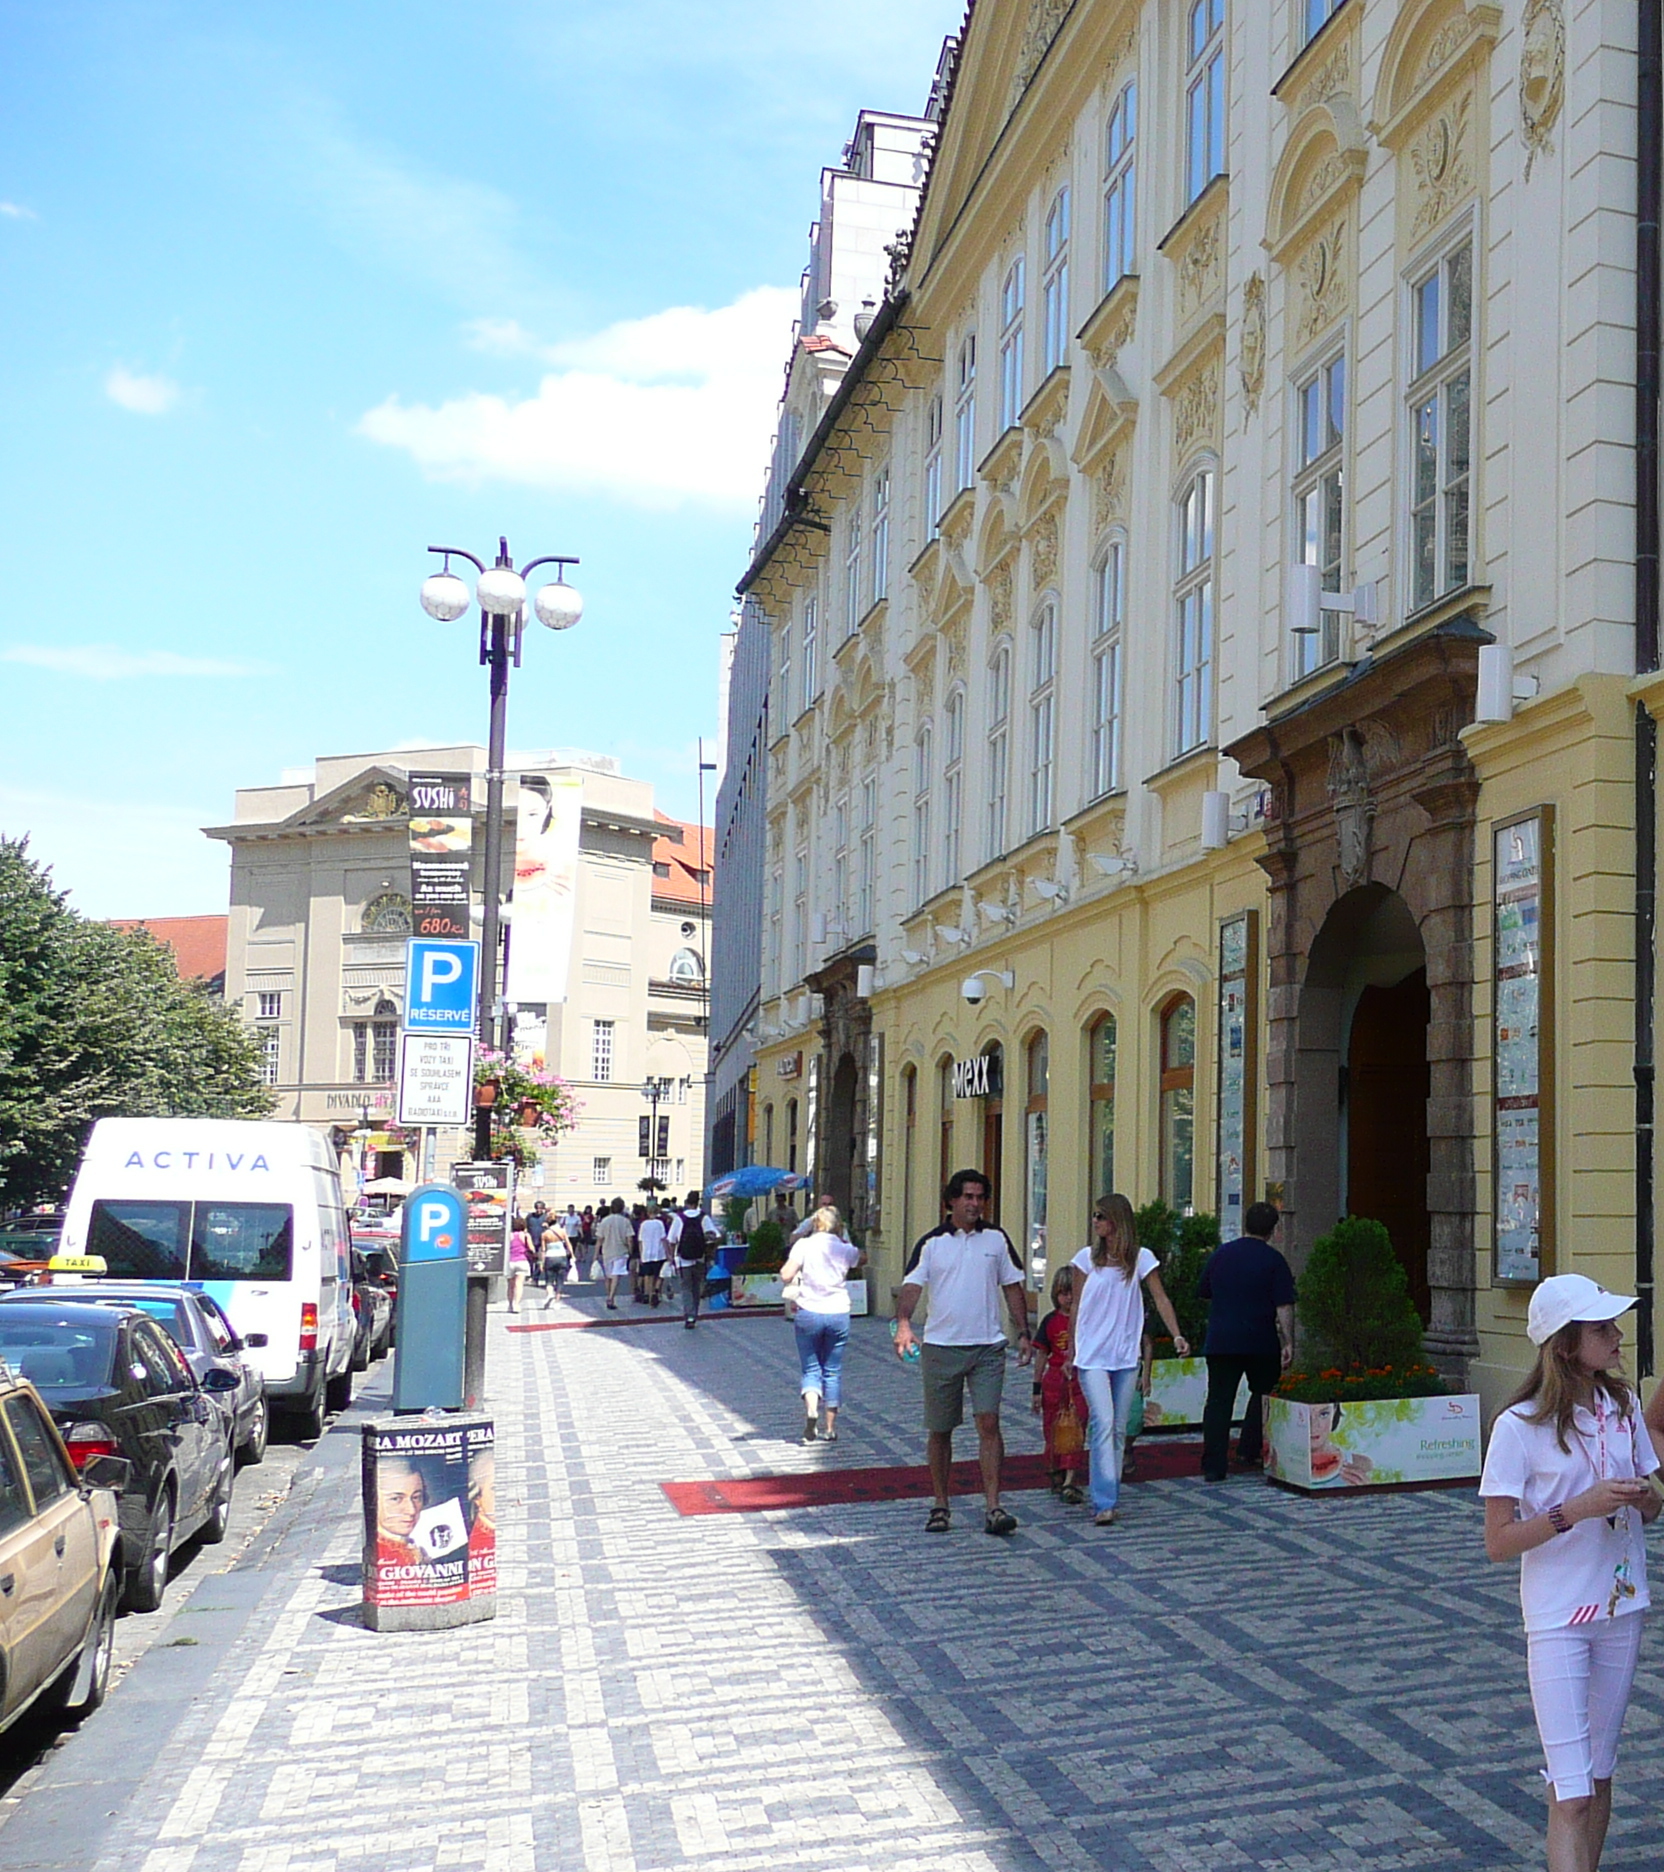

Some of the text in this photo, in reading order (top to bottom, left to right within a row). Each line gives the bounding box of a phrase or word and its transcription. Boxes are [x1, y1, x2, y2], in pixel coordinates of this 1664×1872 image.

[420, 917, 451, 934] 680
[421, 951, 463, 1002] P
[409, 1006, 471, 1022] RÉSERVÉ
[439, 1055, 454, 1065] TAXI
[124, 1151, 270, 1172] ACTIVA
[420, 1202, 451, 1242] P
[65, 1258, 91, 1268] TAXI
[395, 1431, 463, 1449] MOZART
[1420, 1438, 1475, 1451] Refreshing
[379, 1560, 465, 1581] GIOVANNI
